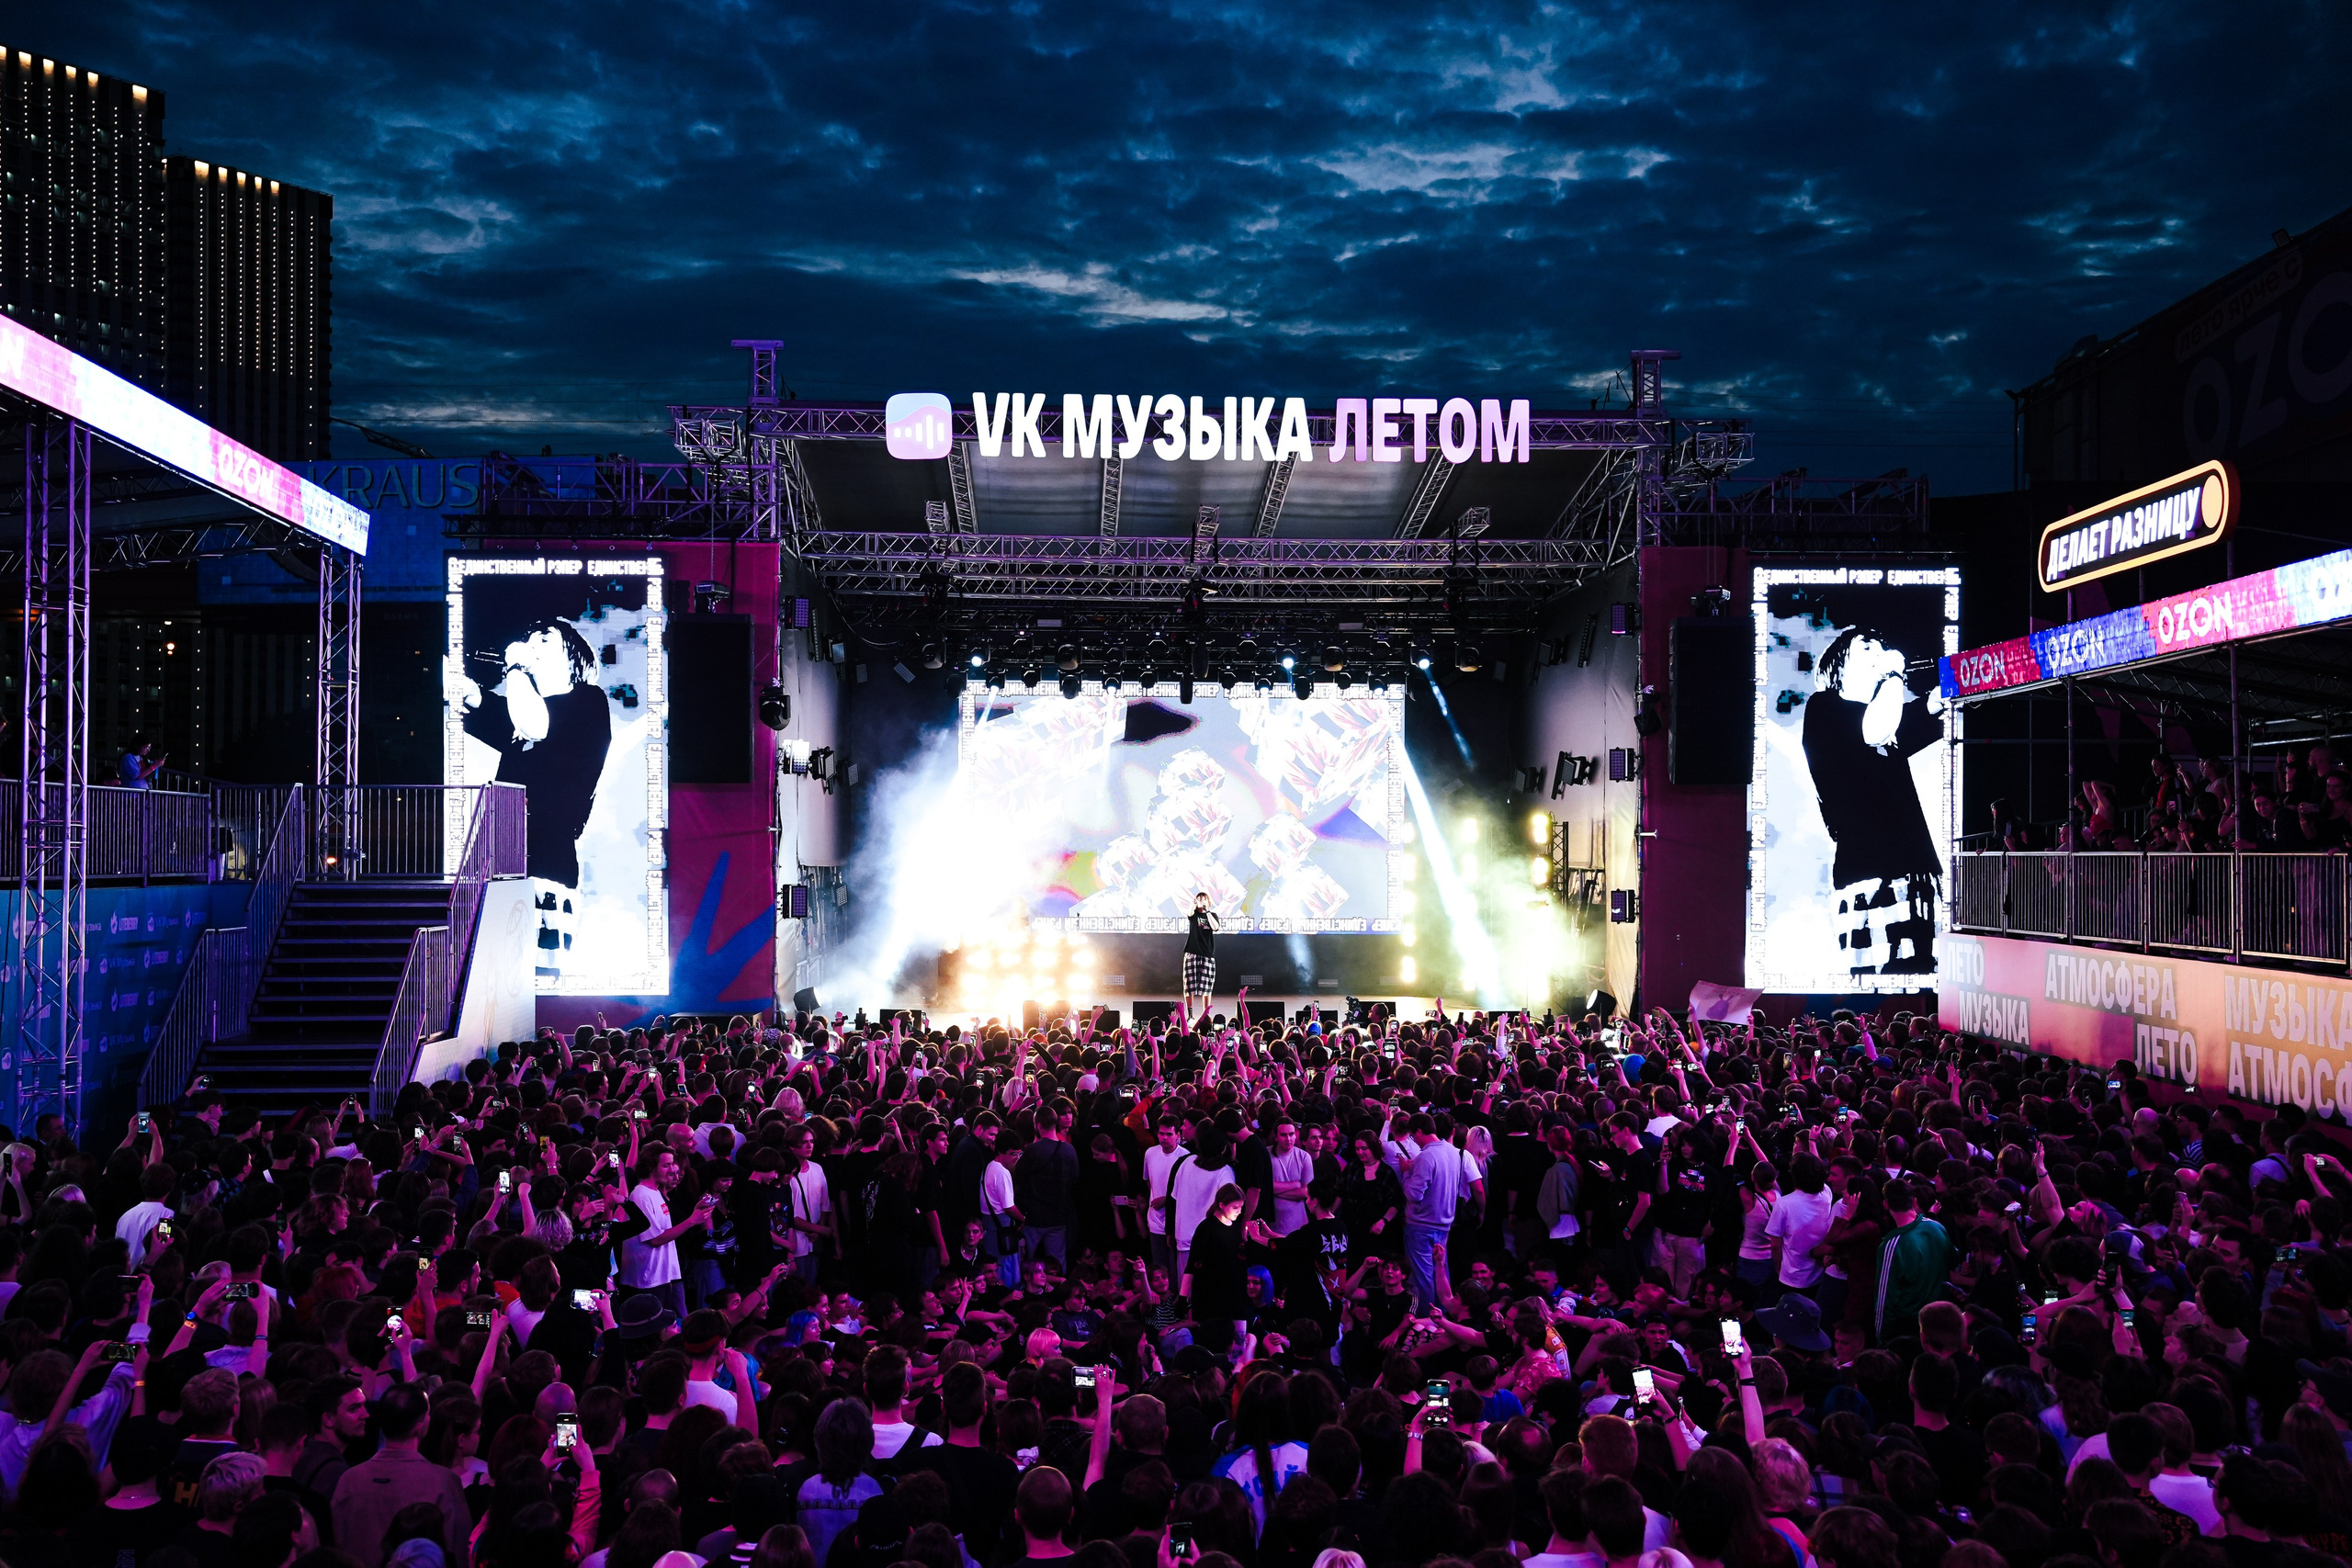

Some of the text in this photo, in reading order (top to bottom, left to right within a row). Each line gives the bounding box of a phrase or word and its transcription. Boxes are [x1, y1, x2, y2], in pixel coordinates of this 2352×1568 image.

[972, 391, 1531, 464] VK МУЗЫКА ЛЕТОМ
[219, 444, 275, 497] OZON
[2046, 487, 2201, 582] ДЕЛАЕТ РАЗНИЦУ
[548, 559, 582, 574] РЭПЕР
[1849, 570, 1883, 584] РЭПЕР
[2158, 591, 2233, 644] OZON
[1960, 650, 2006, 687] OZON
[2047, 626, 2104, 669] OZON
[1860, 974, 1939, 990] ДИНСТВЕННЫЙ
[1946, 941, 1984, 987] ЛЕТО
[2045, 953, 2177, 1021] АТМОСФЕРА
[1959, 990, 2030, 1045] МУЗЫКА
[2224, 975, 2352, 1051] МУЗЫКА
[2134, 1023, 2197, 1085] ЛЕТО
